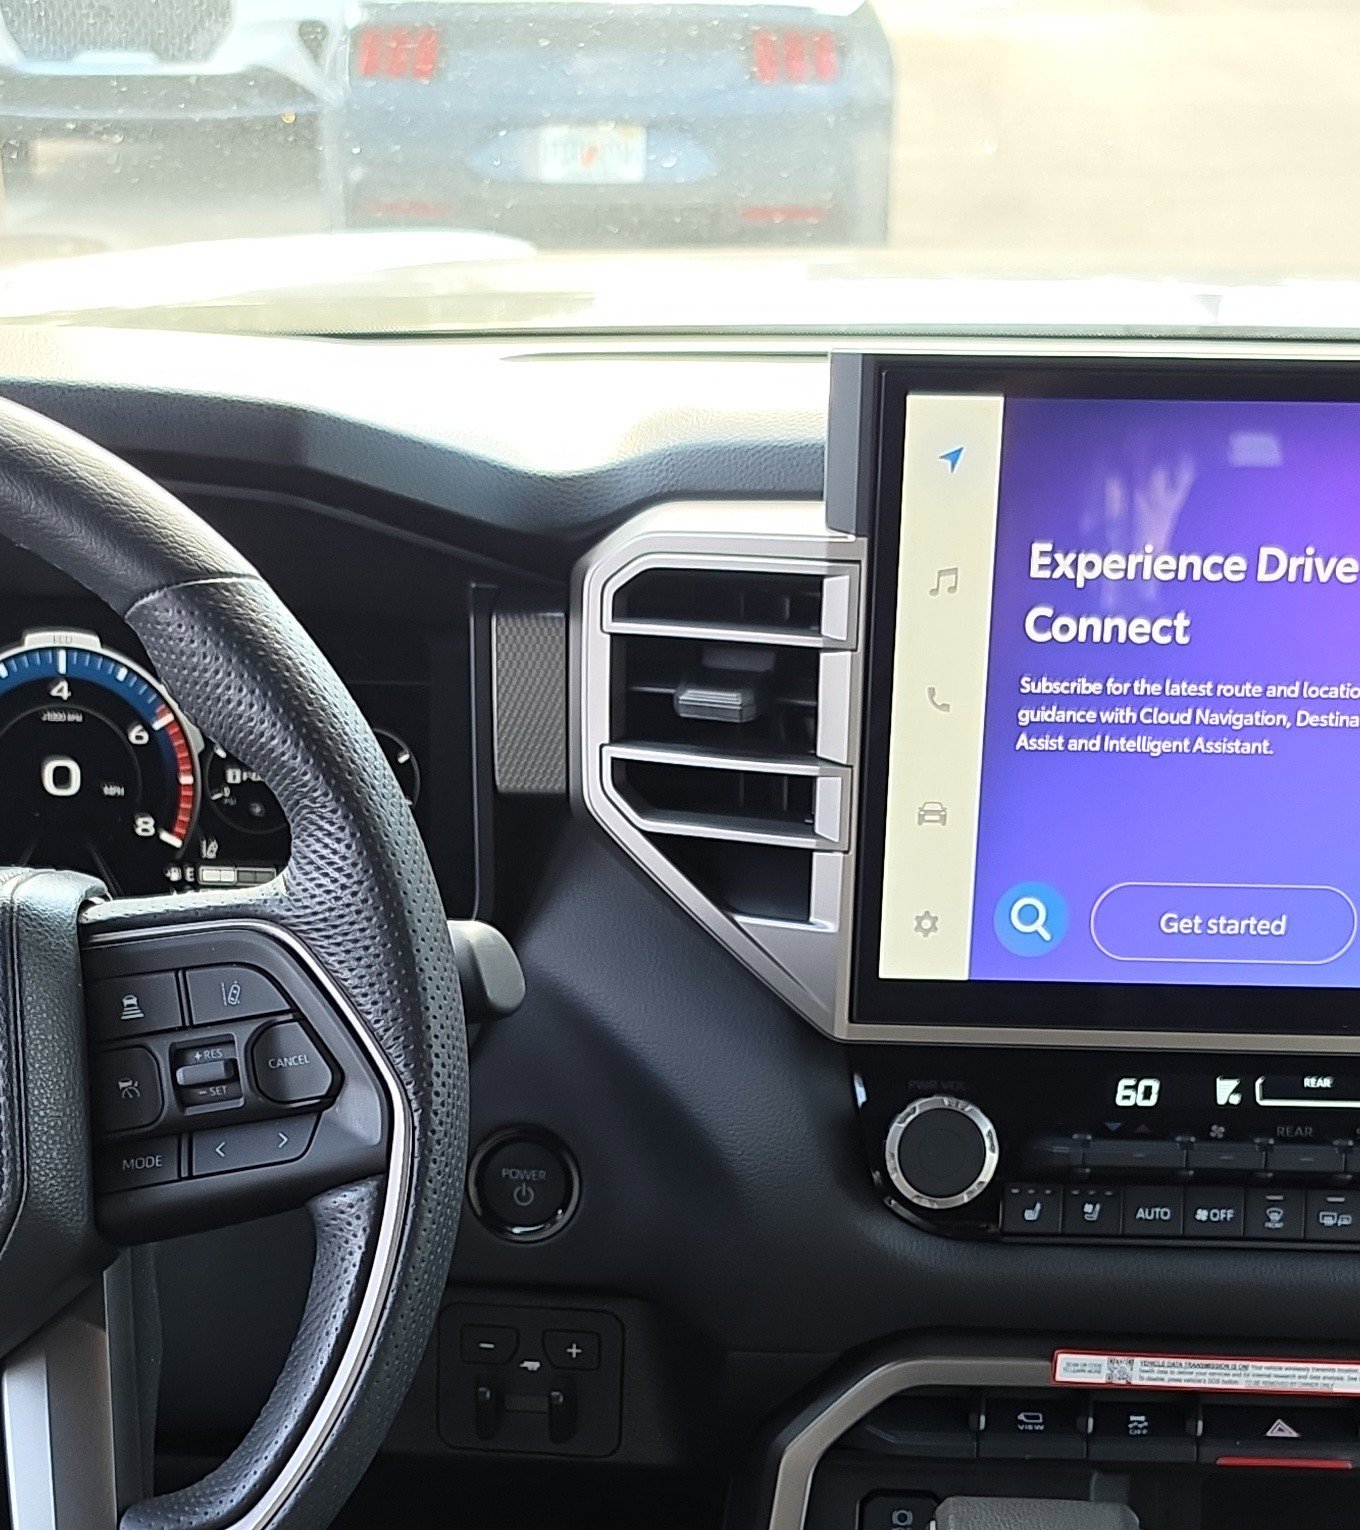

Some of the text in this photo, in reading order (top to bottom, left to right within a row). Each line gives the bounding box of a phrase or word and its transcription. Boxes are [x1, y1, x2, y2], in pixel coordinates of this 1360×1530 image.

[1028, 539, 1360, 588] Experience Drive
[1024, 603, 1191, 645] Connect
[50, 678, 72, 701] 4
[1019, 676, 1104, 695] Subscribe
[1105, 677, 1133, 695] for
[1133, 678, 1163, 696] the
[1164, 679, 1213, 697] latest
[1216, 681, 1263, 698] route
[1265, 680, 1299, 698] and
[1017, 706, 1097, 728] guidance
[1099, 707, 1137, 725] with
[1139, 707, 1192, 726] Cloud
[1195, 708, 1292, 730] Navigation,
[128, 724, 149, 745] 6
[1015, 733, 1275, 756] Assist and Intelligent Assistant.
[42, 756, 82, 796] 0
[134, 815, 156, 836] 8
[1159, 910, 1287, 940] Get started
[267, 1053, 310, 1069] CANCEL
[1114, 1077, 1161, 1107] 60
[1303, 1076, 1334, 1088] REAR
[1276, 1126, 1314, 1138] REAR
[122, 1154, 163, 1169] MODE
[501, 1167, 547, 1182] POWER
[1135, 1207, 1172, 1221] AUTO
[1209, 1208, 1235, 1222] OFF
